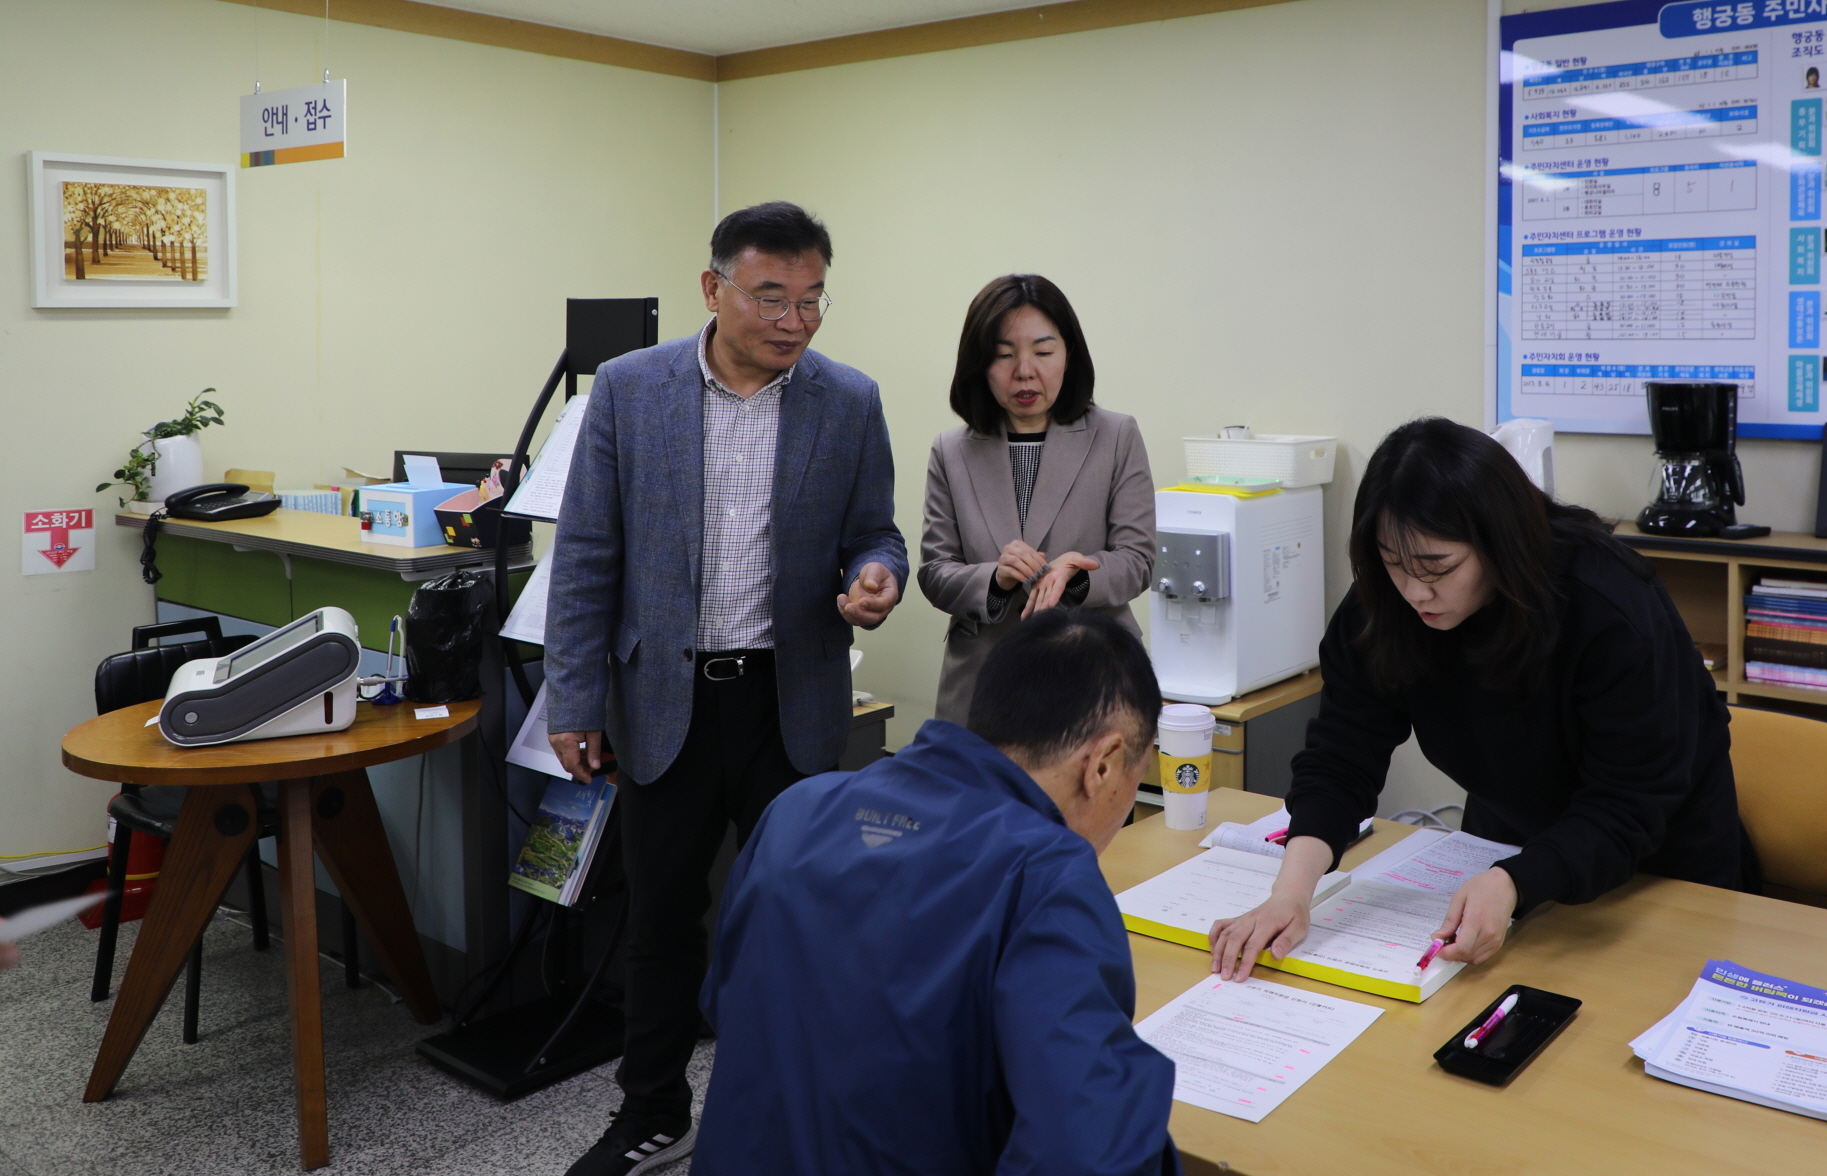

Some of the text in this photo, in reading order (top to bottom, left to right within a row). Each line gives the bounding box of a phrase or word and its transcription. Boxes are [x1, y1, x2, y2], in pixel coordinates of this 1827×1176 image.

[1692, 2, 1756, 30] 행궁동
[1792, 29, 1824, 45] 행궁동
[1791, 45, 1824, 58] 조직도
[1555, 58, 1570, 69] 일반
[1572, 56, 1588, 67] 현황
[262, 98, 332, 137] 안내 접수
[1530, 108, 1577, 121] 사회복지 현황
[1530, 157, 1609, 171] 주민자치센터 운영 현황
[1530, 228, 1642, 241] 주민자치센터 프로그램 운영 현황
[1529, 352, 1600, 362] 주민자치회 운영 현황
[31, 511, 86, 529] 소화기
[375, 509, 404, 527] 소통함
